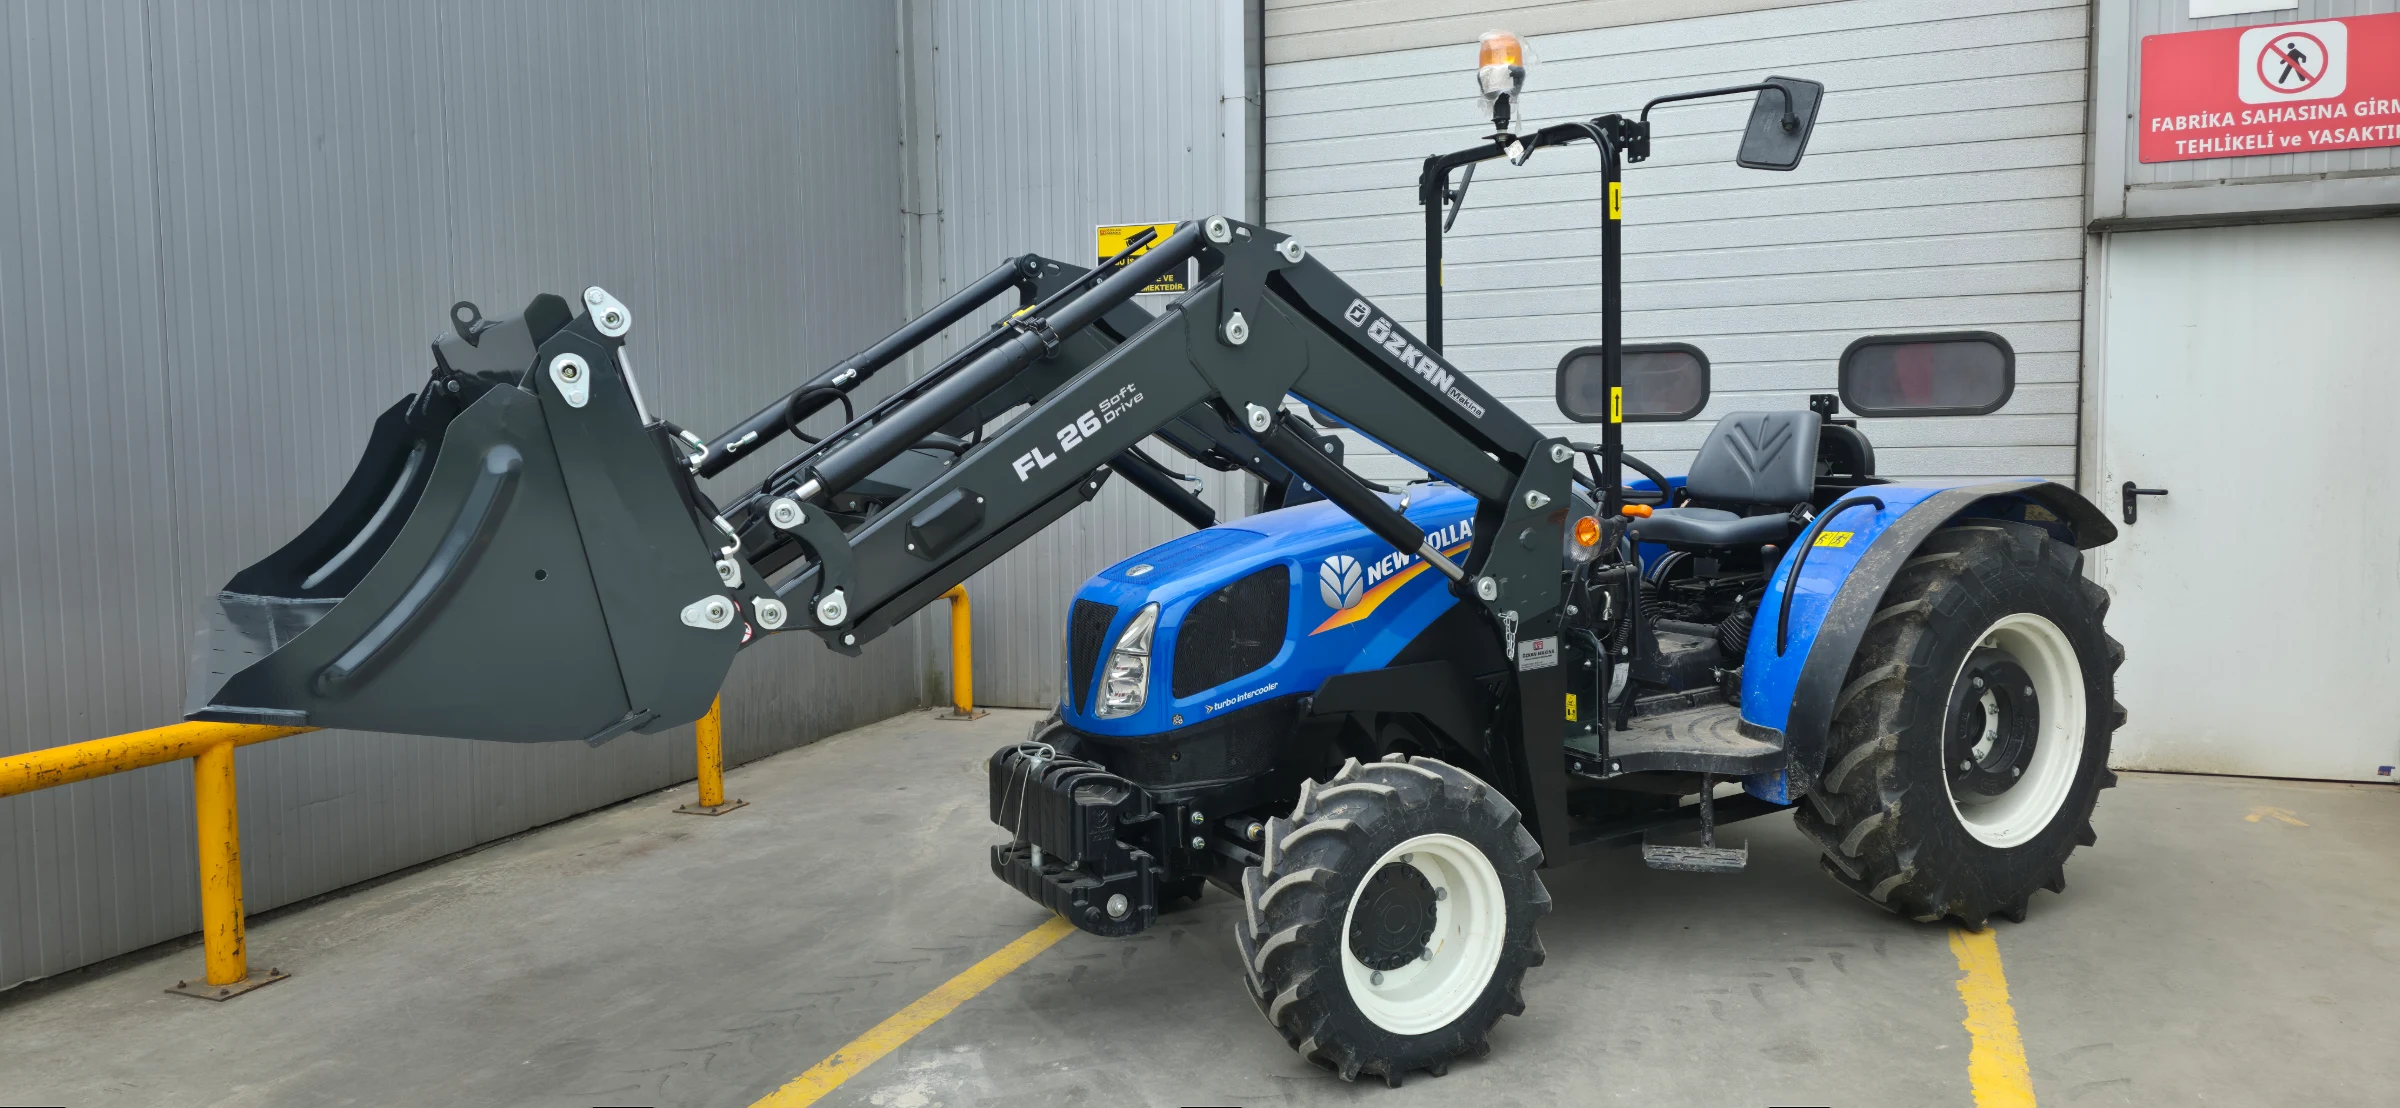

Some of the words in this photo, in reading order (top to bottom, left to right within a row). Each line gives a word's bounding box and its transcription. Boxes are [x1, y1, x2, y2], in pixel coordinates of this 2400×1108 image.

[2152, 110, 2235, 132] FABRİKA
[2241, 103, 2347, 125] SAHASINA
[2176, 130, 2274, 154] TEHLİKELİ
[2280, 135, 2302, 147] ve
[1141, 282, 1185, 291] MEKTEDİR.
[1367, 316, 1456, 394] ÖZKAN
[1449, 388, 1484, 417] Makina
[1099, 383, 1136, 412] Soft
[1103, 392, 1144, 424] Drive
[1012, 446, 1058, 482] FL
[1056, 409, 1102, 453] 26
[1367, 551, 1410, 585] NEW
[1416, 517, 1475, 560] OLLA
[1214, 697, 1236, 711] turbo
[1237, 682, 1279, 703] intercooler
